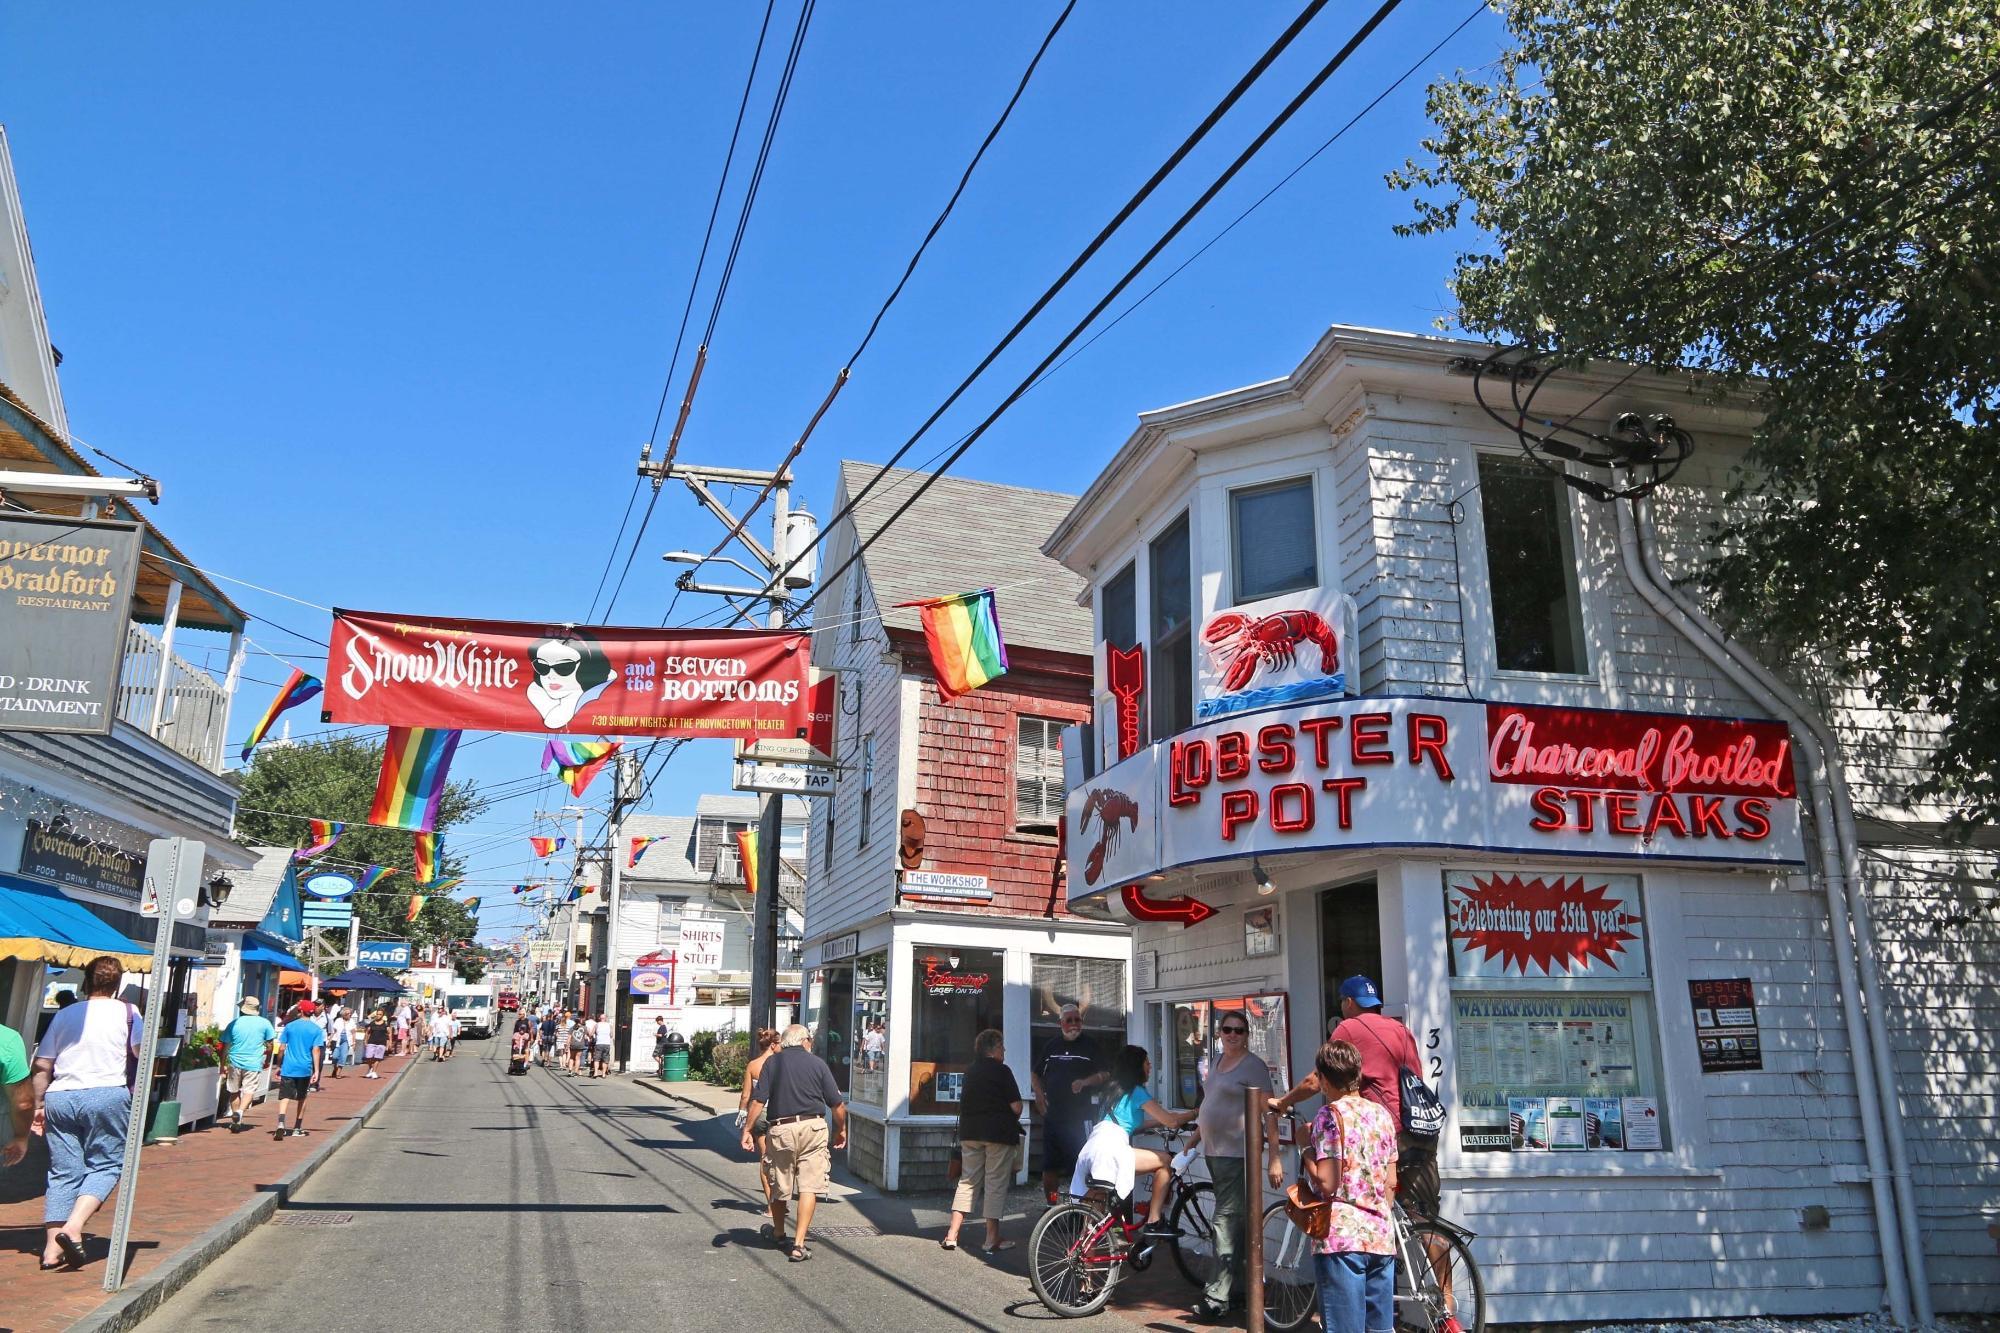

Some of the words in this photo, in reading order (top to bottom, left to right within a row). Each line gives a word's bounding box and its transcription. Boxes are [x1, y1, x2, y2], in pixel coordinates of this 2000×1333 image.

[16, 595, 110, 612] RESTAURANT
[624, 656, 656, 680] and
[664, 656, 747, 677] SEVEN
[26, 677, 90, 694] DRINK
[625, 678, 654, 693] the
[660, 678, 799, 706] BOTTOMS
[0, 696, 101, 716] TAINMENT
[592, 715, 607, 726] 7:30
[609, 716, 638, 727] SUNDAY
[640, 717, 667, 728] NIGHTS
[668, 718, 678, 728] AT
[680, 718, 694, 729] THE
[695, 719, 752, 730] PROVINCETOWN
[754, 719, 785, 731] THEATER
[1169, 712, 1454, 807] LOBSTER
[1490, 713, 1661, 793] Charcoal
[805, 775, 829, 787] TAP
[1221, 777, 1367, 841] POT
[1529, 787, 1773, 841] STEAKS
[35, 864, 56, 877] FOOD
[65, 872, 88, 886] DRINK
[909, 872, 929, 884] THE
[930, 874, 984, 888] WORKSHOP
[1457, 900, 1532, 940] Celebrating
[1535, 908, 1557, 933] our
[1560, 902, 1589, 933] 35th
[682, 929, 722, 943] SHIRTS
[360, 949, 407, 961] PATIO
[683, 954, 719, 965] STUFF
[955, 987, 967, 995] ON
[1365, 982, 1375, 994] LA
[1457, 999, 1564, 1018] WATERFRONT
[1568, 999, 1627, 1017] DINING
